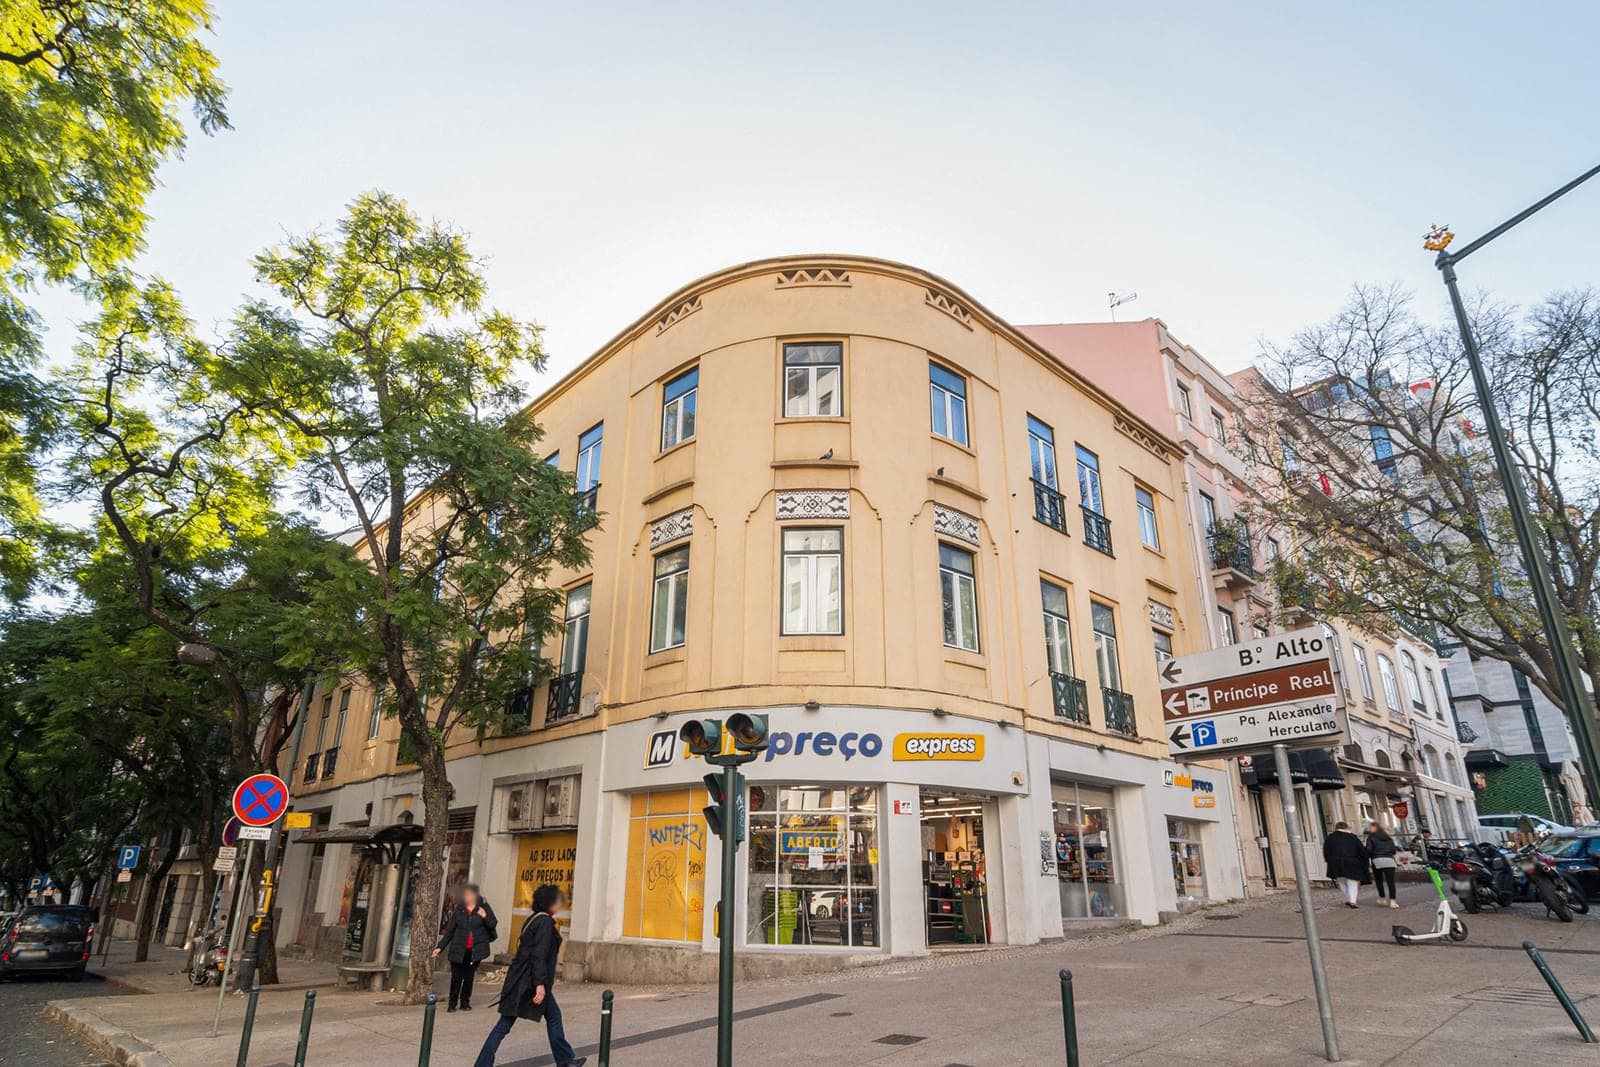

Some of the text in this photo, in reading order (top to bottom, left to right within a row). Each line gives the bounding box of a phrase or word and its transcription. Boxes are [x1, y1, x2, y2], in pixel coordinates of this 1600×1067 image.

[1275, 637, 1323, 660] Alto
[1213, 670, 1331, 704] Príncipe Real
[1239, 702, 1333, 727] Pq. Alexandre
[1198, 727, 1210, 745] P
[1268, 720, 1337, 737] Herculano
[648, 731, 676, 765] M
[906, 737, 976, 758] express
[787, 836, 839, 848] ABERTO
[122, 849, 135, 866] P
[529, 849, 539, 862] AO
[541, 848, 555, 862] SEU
[521, 869, 534, 882] AOS
[536, 869, 564, 884] PREÇOS
